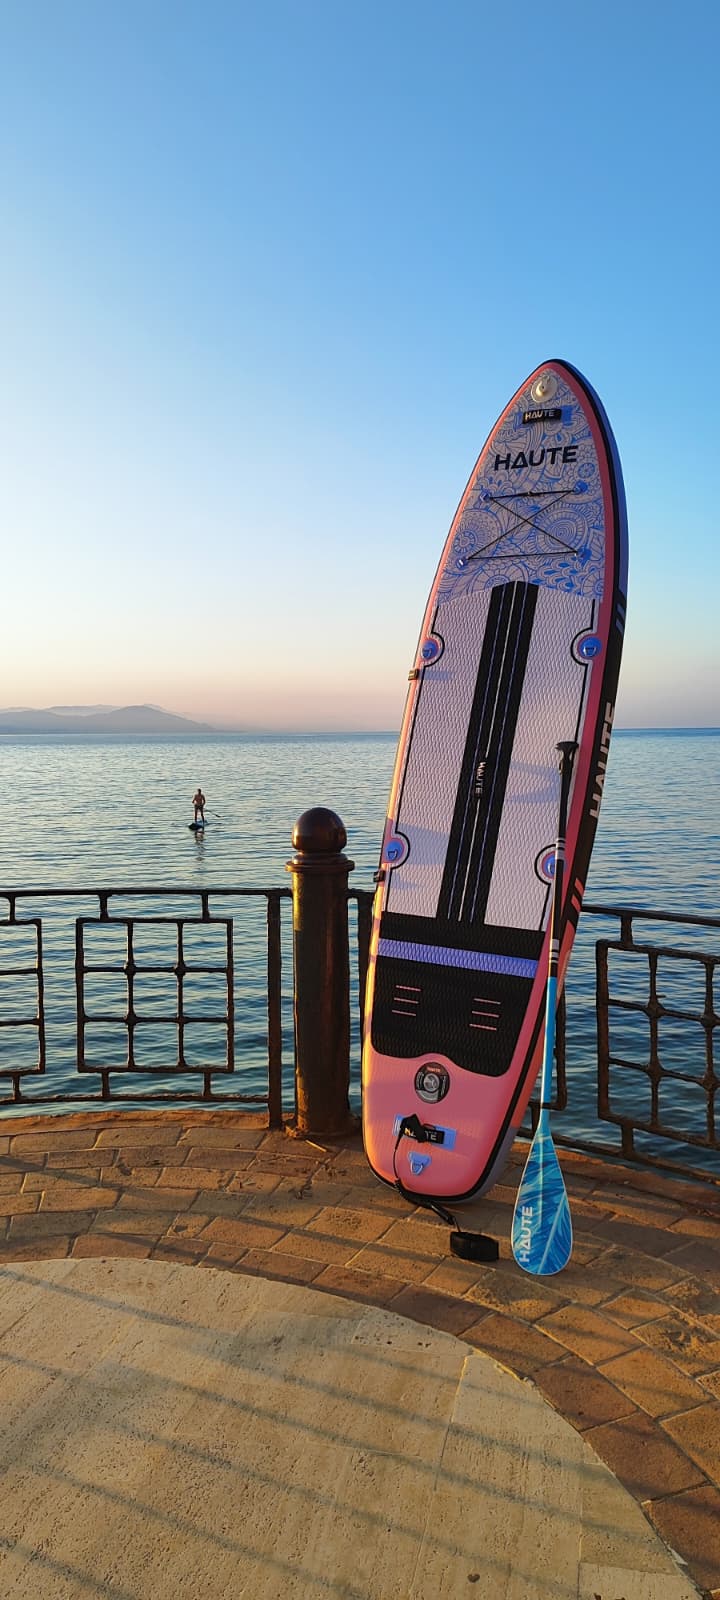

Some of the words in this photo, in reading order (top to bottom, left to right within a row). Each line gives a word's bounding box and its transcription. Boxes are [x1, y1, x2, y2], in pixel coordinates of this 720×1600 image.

[524, 410, 555, 421] HAUTE
[493, 445, 579, 471] HAUTE
[475, 761, 487, 794] HAUTE
[519, 1205, 533, 1263] HAUTE
